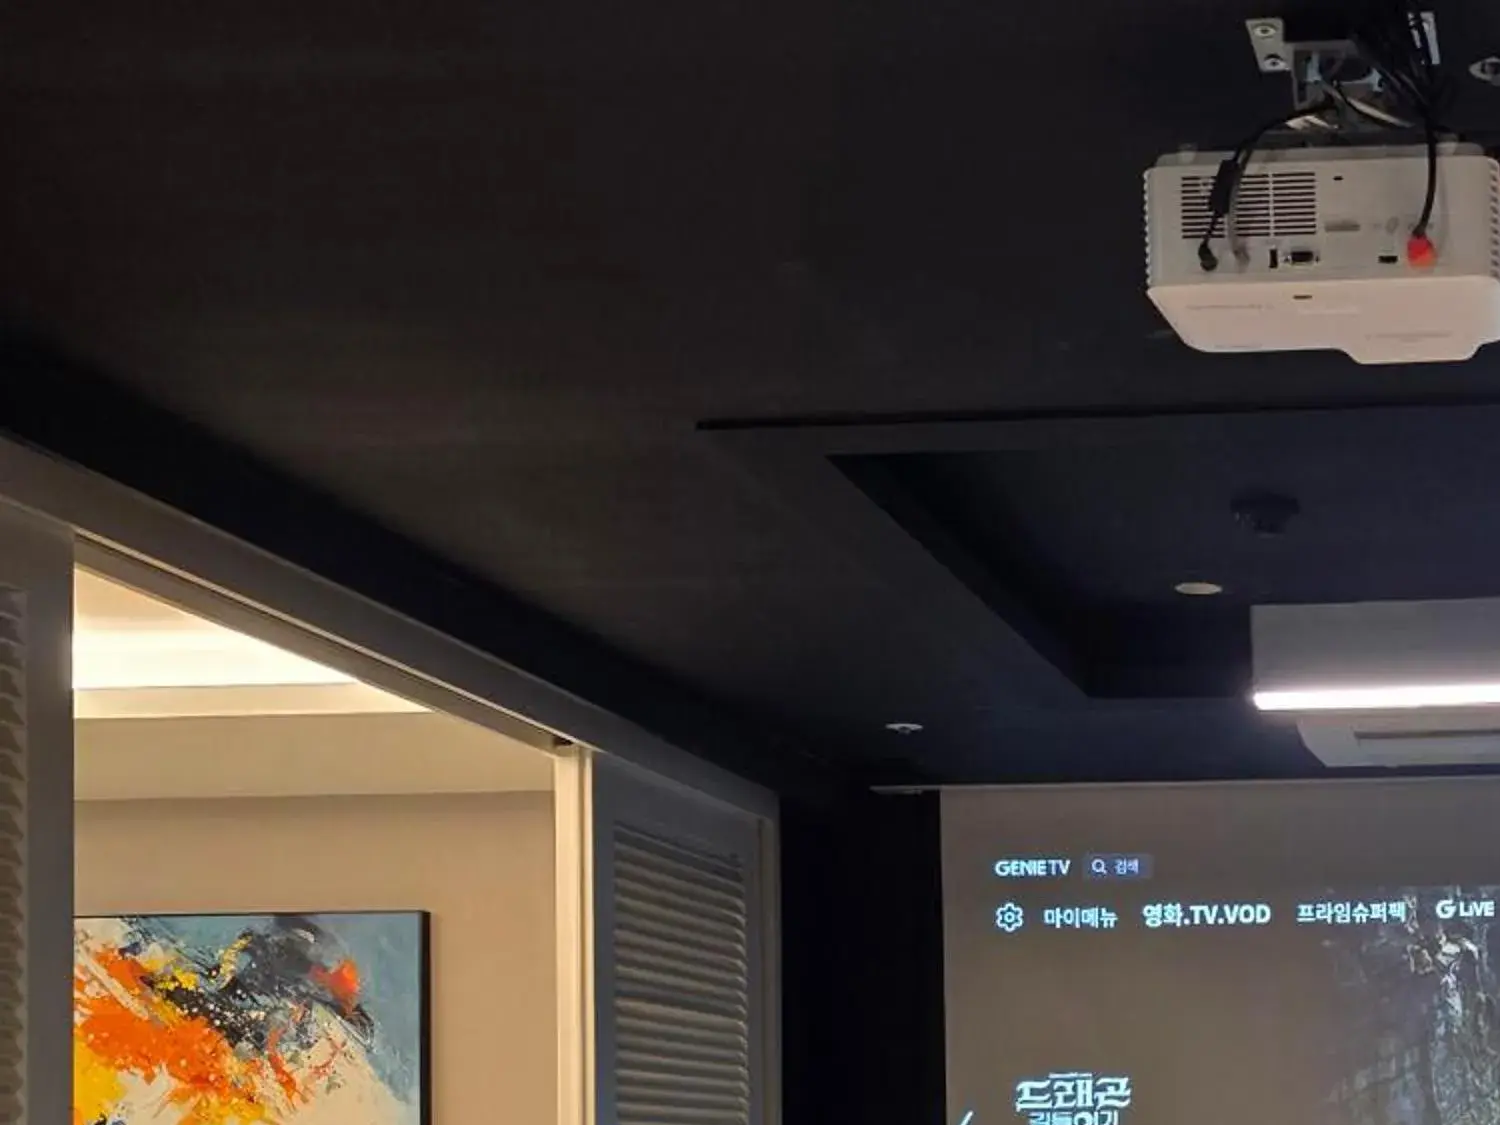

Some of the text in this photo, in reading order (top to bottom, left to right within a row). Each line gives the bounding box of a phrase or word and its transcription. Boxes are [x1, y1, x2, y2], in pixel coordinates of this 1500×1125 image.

[1043, 905, 1118, 929] 마이메뉴
[1143, 902, 1271, 928] 영화.TV.VOD
[1296, 900, 1407, 924] 프라임슈퍼팩
[1015, 1077, 1131, 1112] 드래곤
